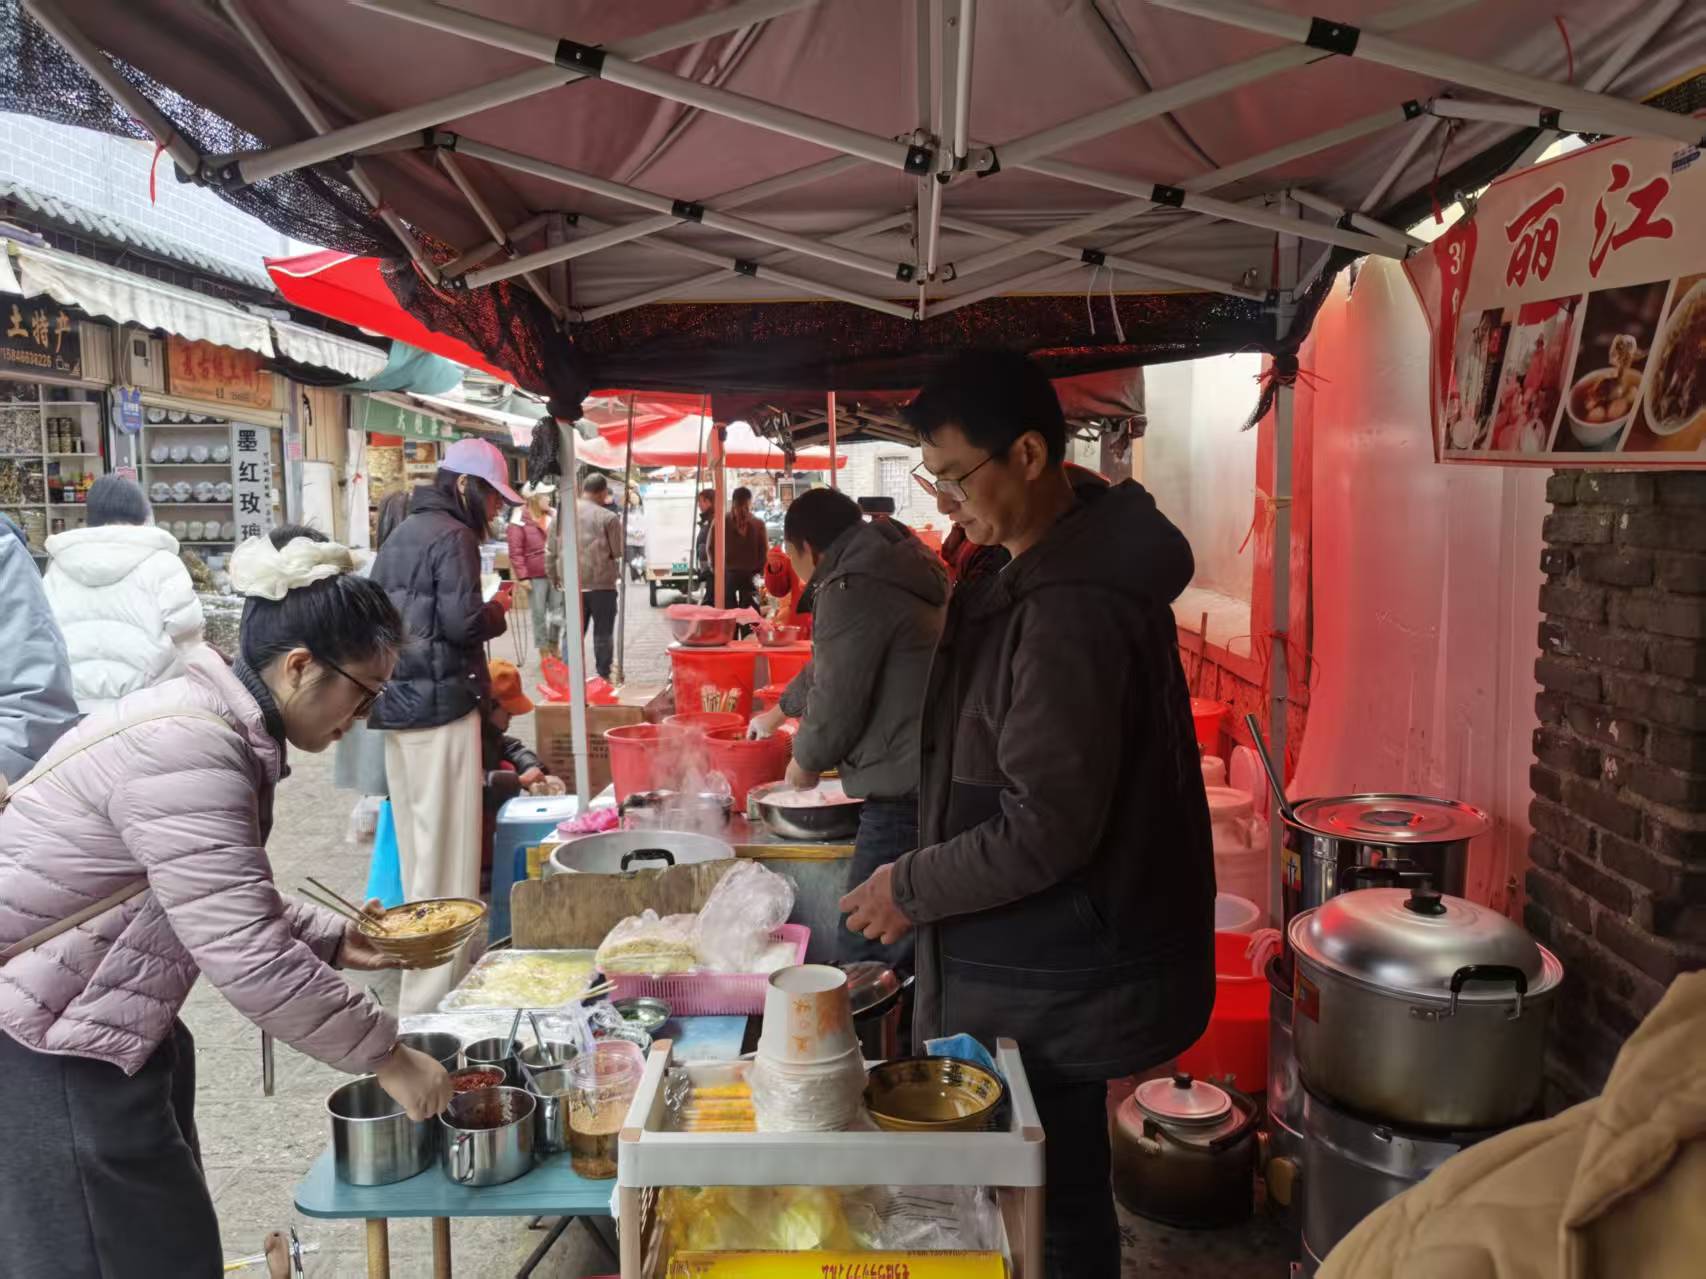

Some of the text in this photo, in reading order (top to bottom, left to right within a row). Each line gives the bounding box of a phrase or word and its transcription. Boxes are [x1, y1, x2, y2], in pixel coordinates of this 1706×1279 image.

[1506, 163, 1673, 287] 丽江
[8, 303, 71, 353] 土特产
